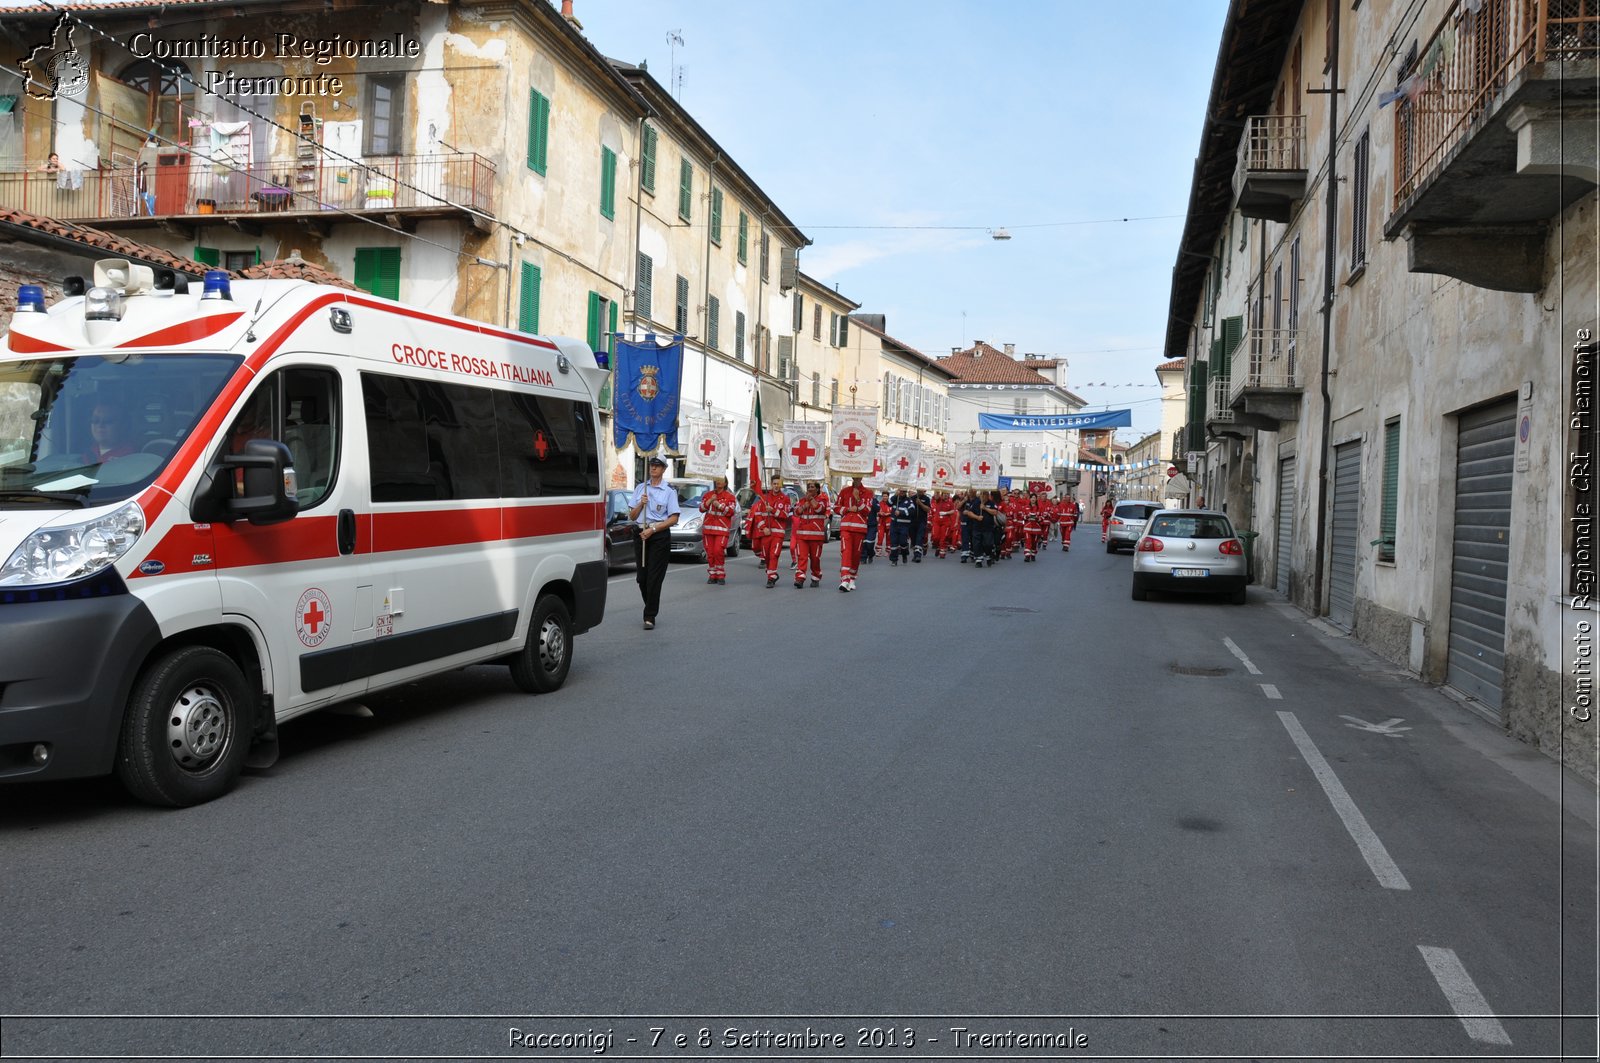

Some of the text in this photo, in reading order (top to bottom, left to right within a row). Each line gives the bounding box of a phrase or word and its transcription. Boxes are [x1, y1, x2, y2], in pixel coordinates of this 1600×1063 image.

[391, 343, 554, 387] CROCE ROSSA ITALIANA
[1012, 417, 1096, 426] ARRIVEDERCI
[377, 614, 393, 626] CN 12
[298, 623, 330, 645] RACCONIGI
